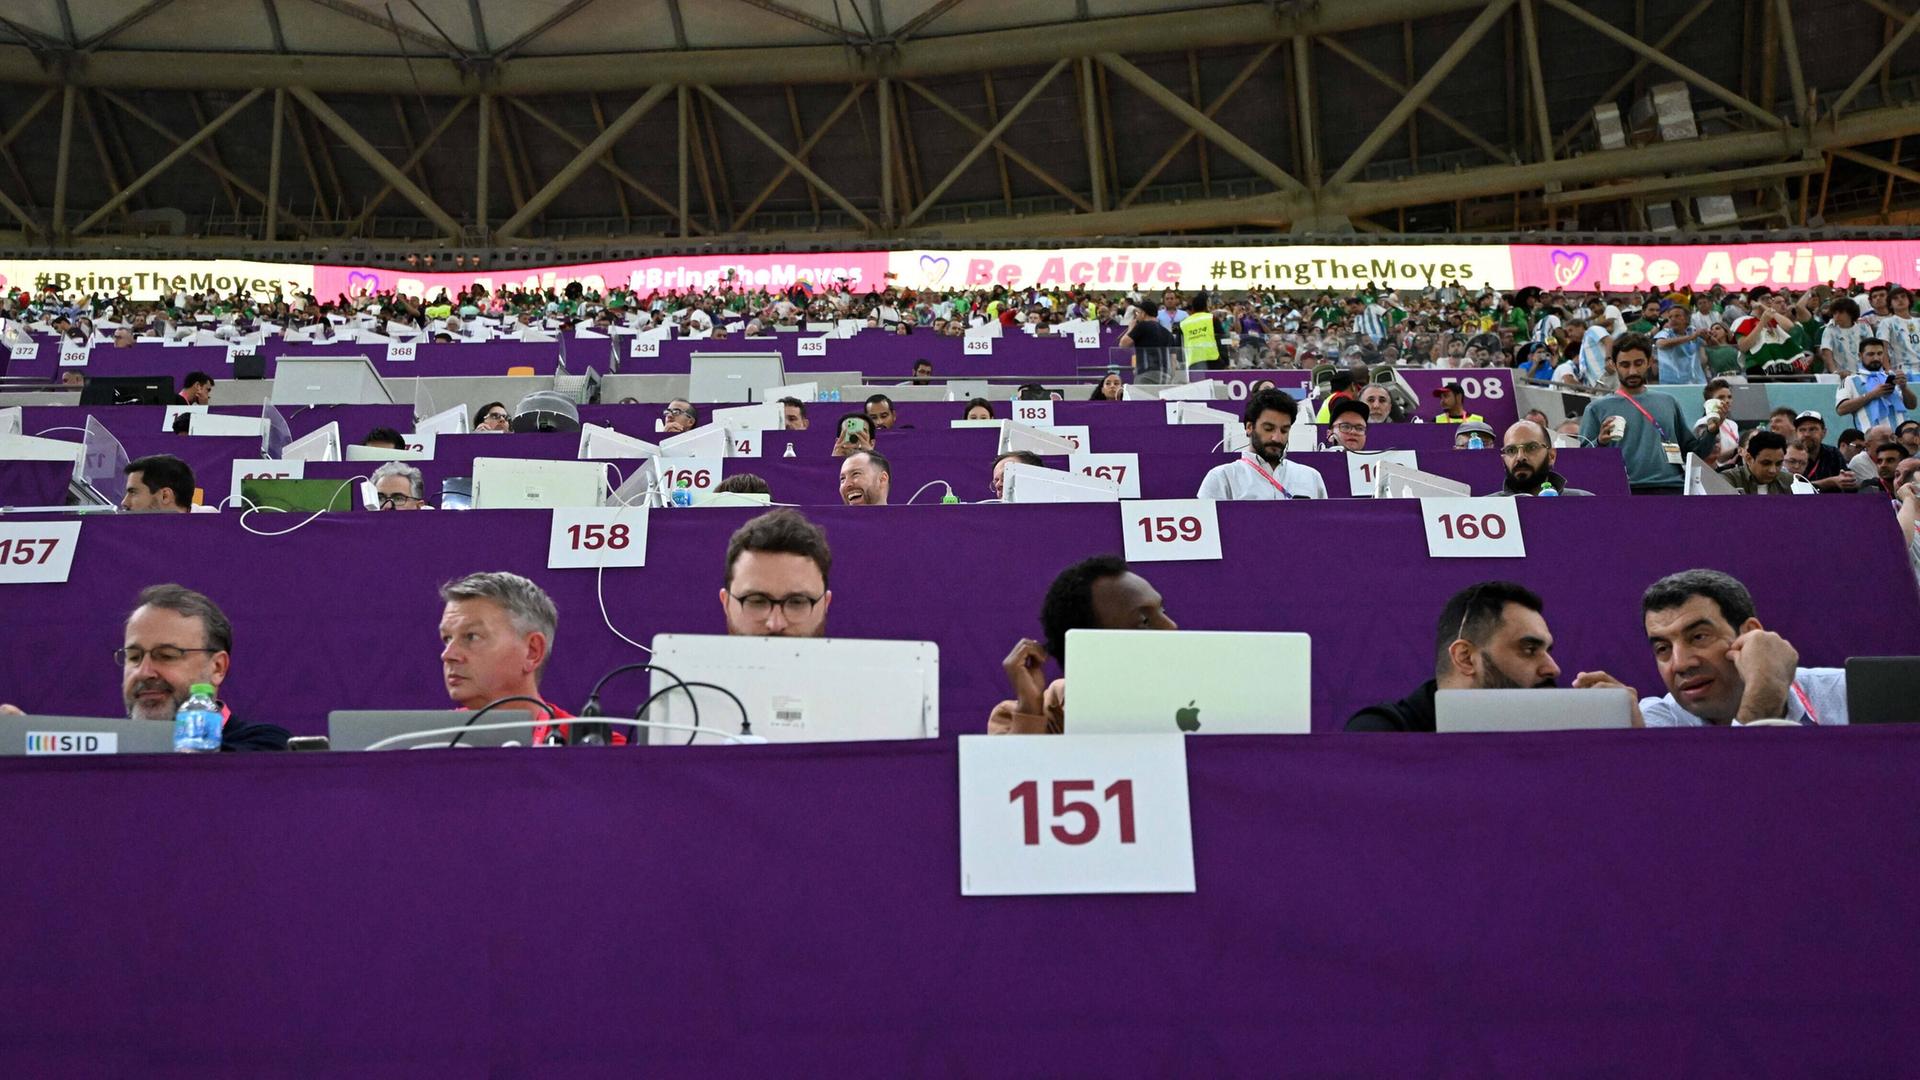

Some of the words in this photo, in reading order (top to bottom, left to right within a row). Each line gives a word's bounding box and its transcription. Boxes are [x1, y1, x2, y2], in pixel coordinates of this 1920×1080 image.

[965, 258, 1022, 285] Be
[1036, 255, 1182, 284] Active
[1210, 258, 1473, 285] #BringTheMoves
[1609, 253, 1680, 286] Be
[1695, 248, 1883, 284] Active
[634, 343, 655, 352] 434
[801, 342, 822, 351] 435
[967, 341, 989, 350] 436
[1077, 336, 1097, 344] 442
[15, 347, 34, 355] 372
[64, 352, 85, 361] 366
[391, 347, 412, 356] 368
[1019, 407, 1046, 419] 183
[664, 469, 711, 489] 166
[1138, 516, 1202, 543] 159
[1438, 513, 1506, 539] 160
[567, 523, 630, 550] 158
[0, 538, 60, 565] 157
[60, 735, 99, 752] SID
[1009, 778, 1136, 846] 151
